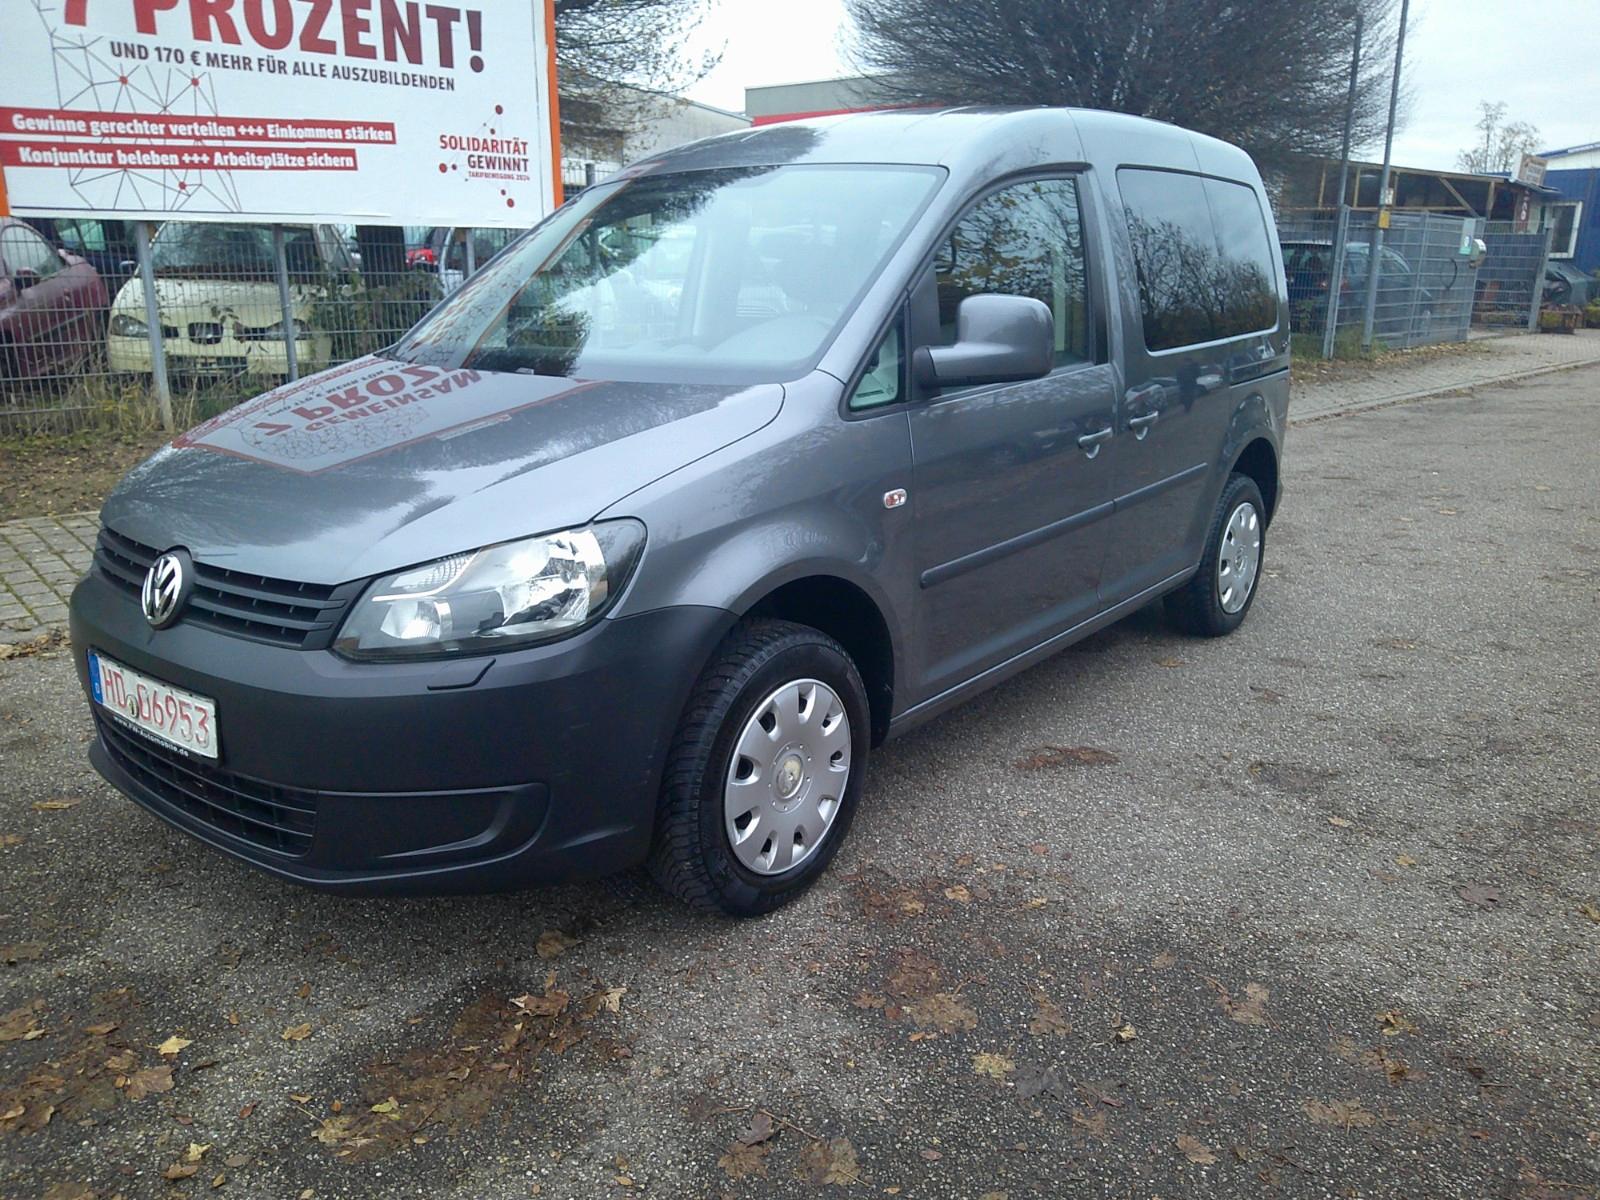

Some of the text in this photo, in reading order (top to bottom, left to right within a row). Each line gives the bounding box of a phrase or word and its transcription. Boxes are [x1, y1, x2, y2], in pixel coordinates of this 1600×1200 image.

[132, 0, 484, 73] PROZENT!
[110, 41, 455, 91] UND 170 € MEHR FÜR ALLE AUSZUBILDENDEN
[12, 113, 87, 132] Gewinne
[89, 119, 166, 136] gerechter
[169, 121, 236, 137] verteilen
[266, 124, 343, 139] Einkommen
[344, 127, 393, 141] stärken
[19, 147, 114, 166] Konjunktur
[117, 150, 179, 165] beleben
[213, 151, 305, 169] Arbeitsplätze
[307, 152, 354, 167] sichern
[440, 134, 528, 155] SOLIDARITÄT
[468, 154, 528, 172] GEWINNT
[102, 664, 127, 709] HD
